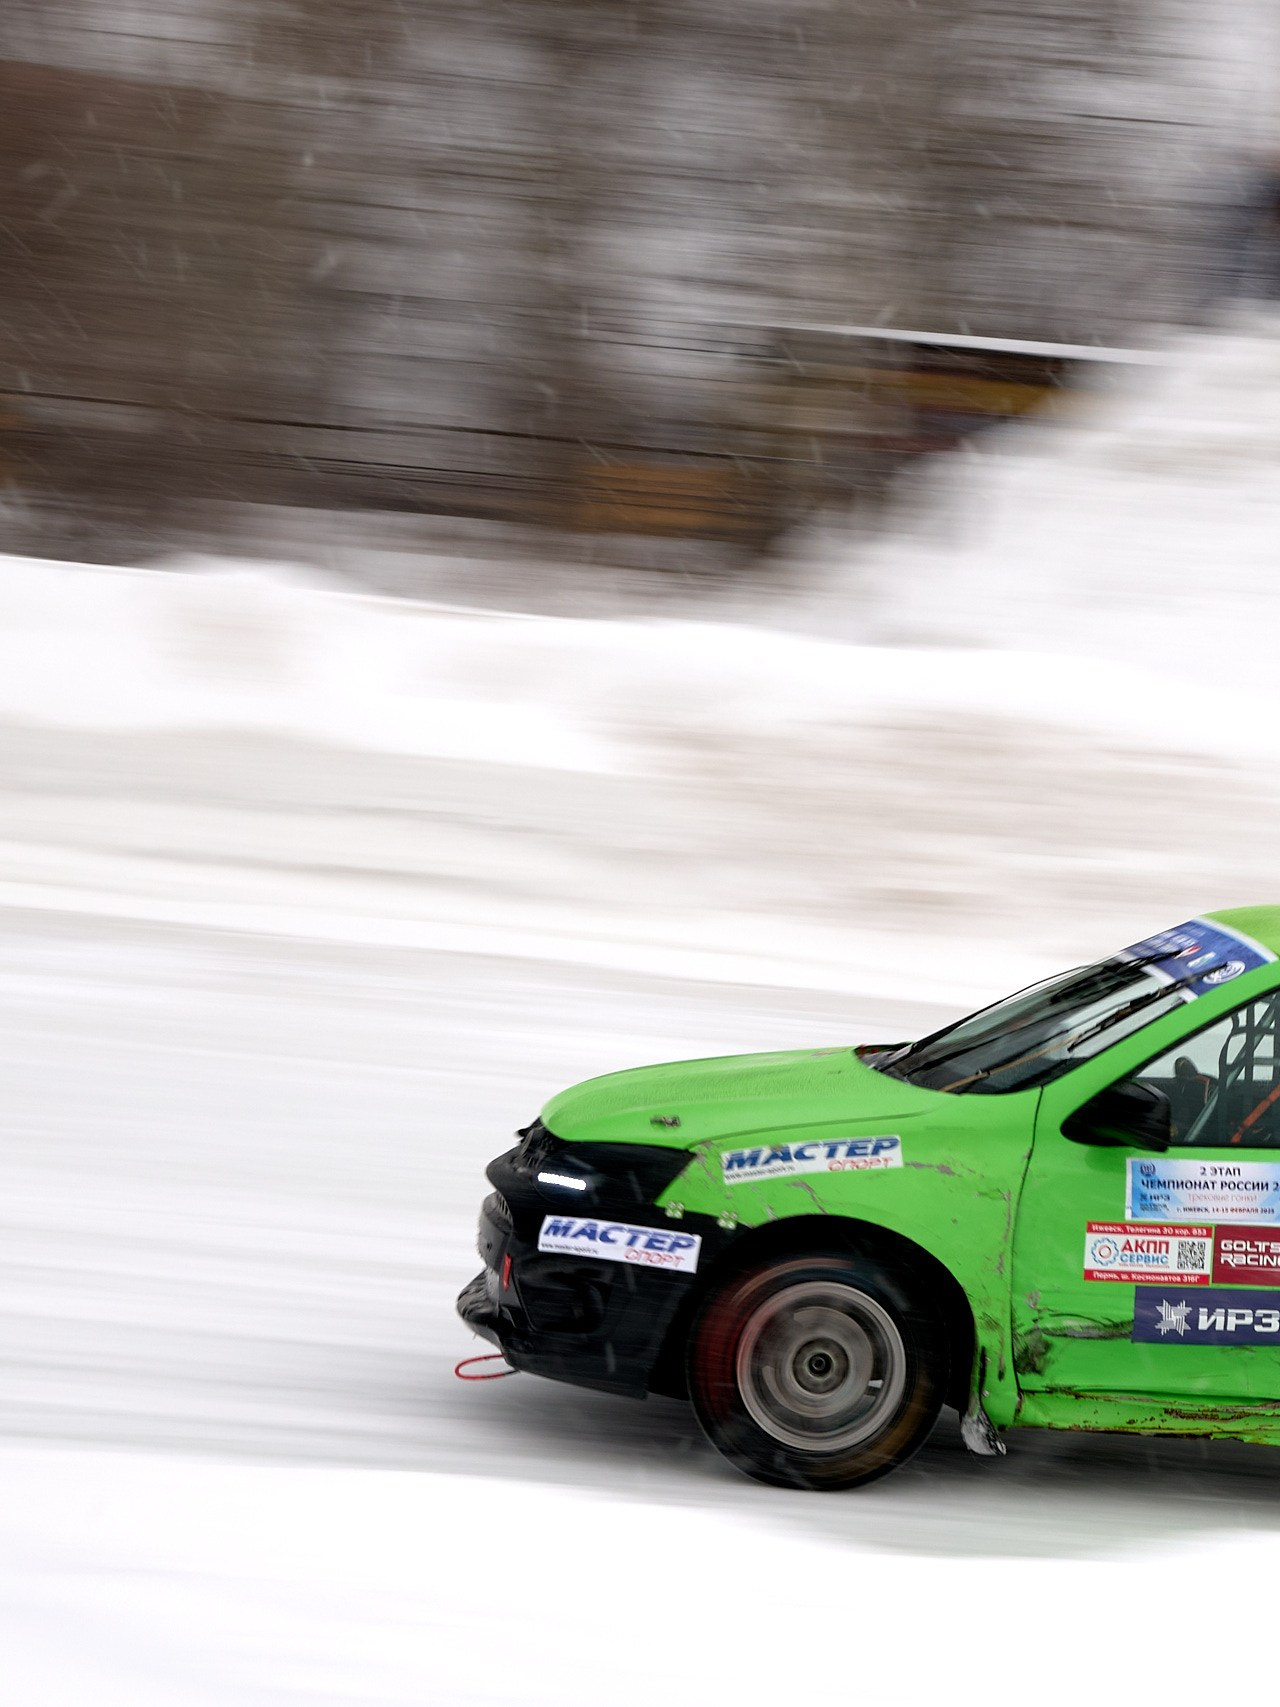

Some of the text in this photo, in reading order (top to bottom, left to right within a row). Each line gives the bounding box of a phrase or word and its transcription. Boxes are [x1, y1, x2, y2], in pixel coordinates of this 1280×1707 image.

[725, 1136, 900, 1170] МАСТЕР
[827, 1157, 893, 1171] СПОРТ
[1200, 1166, 1241, 1177] 2 ЭТАП
[1141, 1180, 1217, 1191] ЧЕМПИОНАТ
[1220, 1181, 1269, 1192] РОССИИ
[543, 1218, 696, 1252] МАСТЕР
[1091, 1224, 1124, 1233] Ижевск,
[1175, 1229, 1191, 1237] кор.
[1121, 1239, 1170, 1254] АКПП
[624, 1248, 685, 1267] СПОРТ
[1120, 1253, 1169, 1265] СЕРВИС
[1198, 1308, 1280, 1333] ИРЗ
